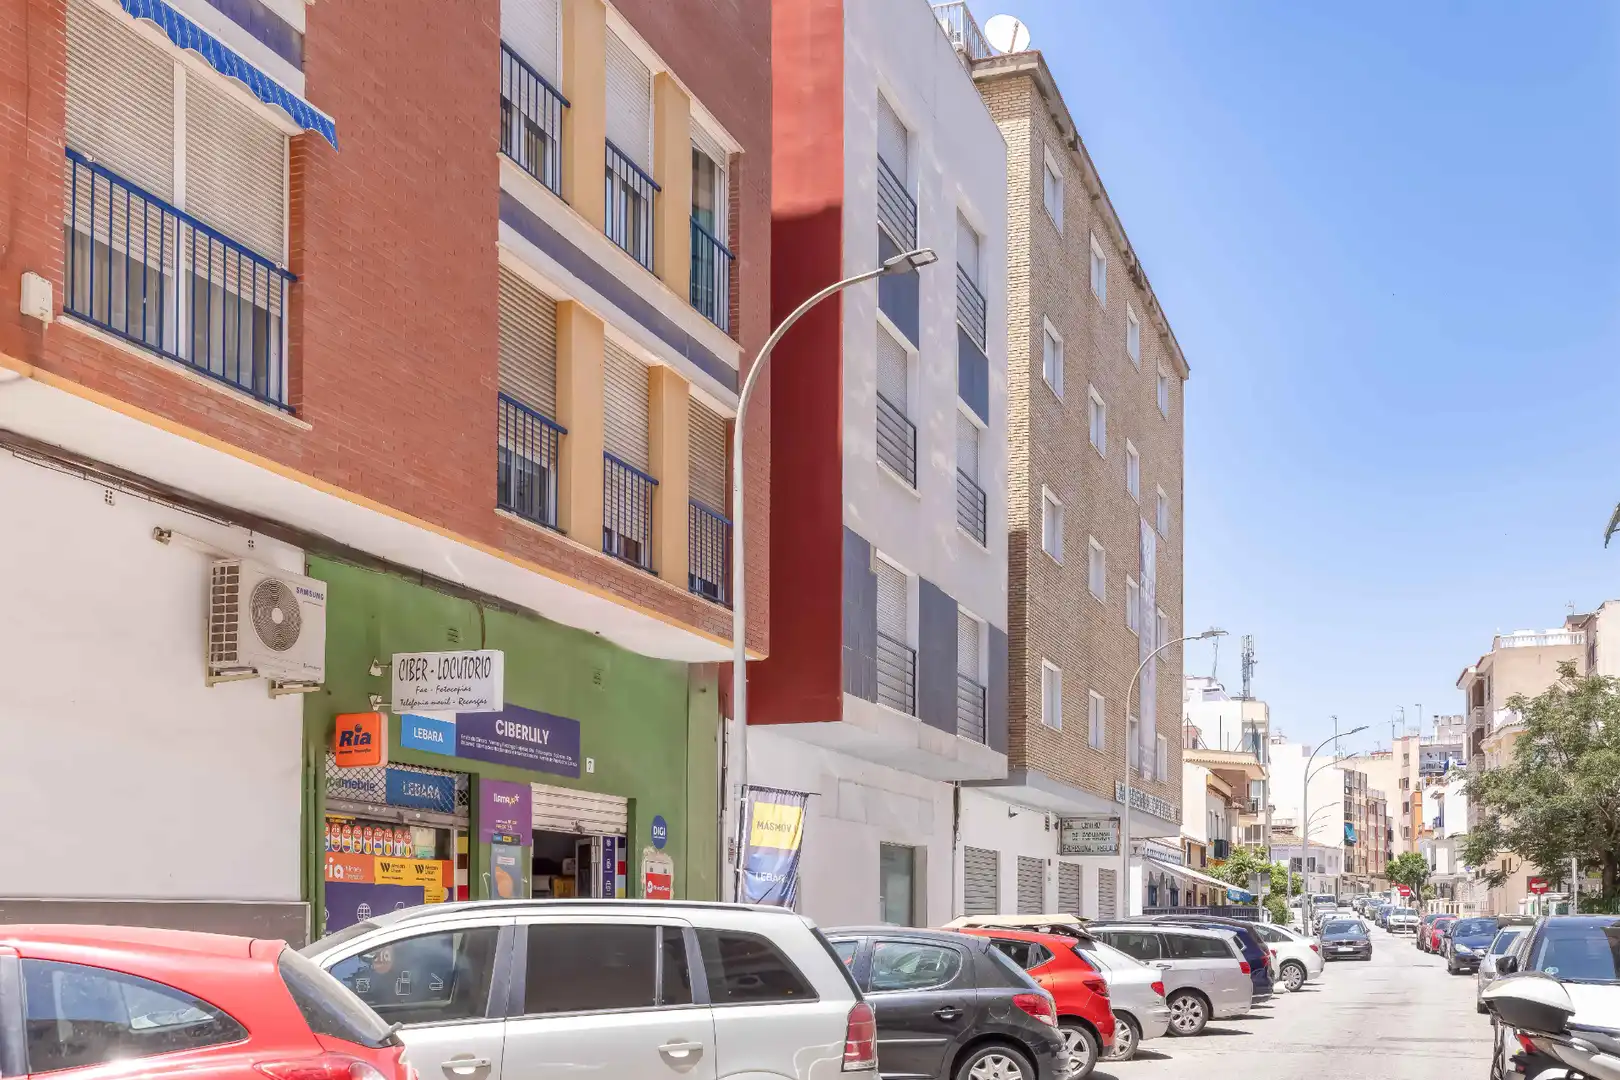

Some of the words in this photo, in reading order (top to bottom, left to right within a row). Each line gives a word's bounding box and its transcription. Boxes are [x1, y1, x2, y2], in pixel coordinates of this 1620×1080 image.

[296, 586, 324, 601] SAMSUNG
[398, 658, 428, 681] CIBER
[437, 656, 492, 681] LOCUTORIO
[436, 684, 472, 694] Fotocopias
[339, 723, 372, 747] Ria
[413, 727, 444, 743] LEBARA
[495, 719, 550, 745] CIBERLILY
[402, 780, 441, 801] LEBARA
[653, 825, 666, 836] DIGI
[325, 857, 344, 879] ia
